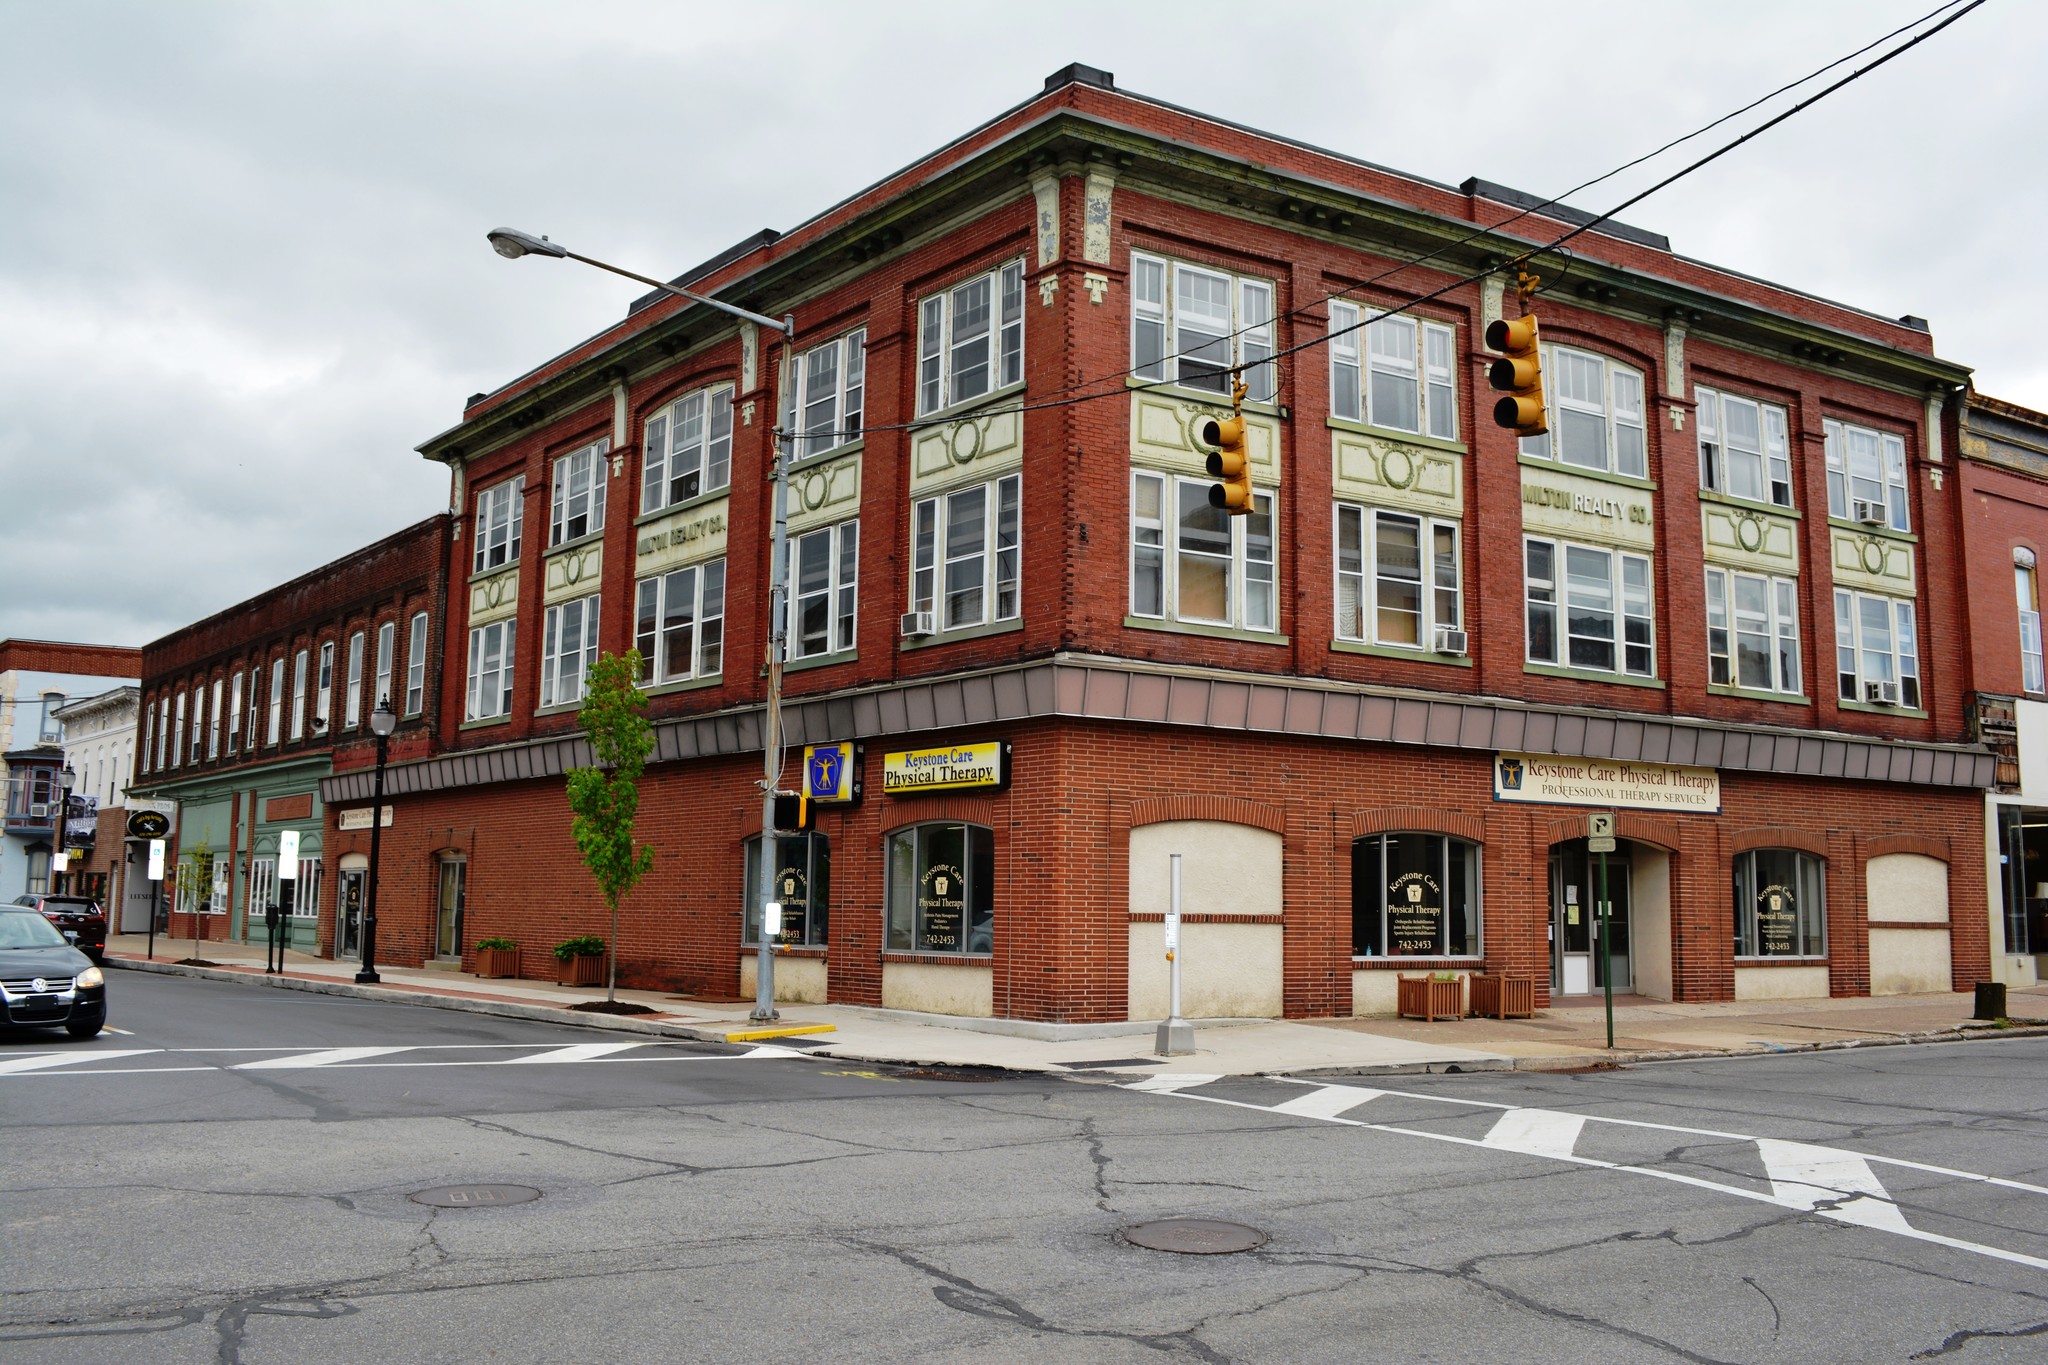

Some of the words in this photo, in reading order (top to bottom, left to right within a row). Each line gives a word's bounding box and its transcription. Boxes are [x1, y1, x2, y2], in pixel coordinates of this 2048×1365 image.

[1523, 484, 1571, 510] MILTON
[1574, 493, 1626, 520] REALTY
[1628, 504, 1652, 525] CO.
[637, 532, 668, 556] MILTON
[670, 519, 708, 546] REALTY
[905, 752, 948, 769] Keystone
[950, 748, 973, 764] Care
[885, 767, 935, 788] Physical
[940, 765, 993, 782] Therapy
[1528, 758, 1583, 782] Keystone
[1587, 763, 1616, 782] Care
[1619, 766, 1667, 788] Physical
[1670, 769, 1716, 794] Therapy
[1541, 784, 1616, 799] PROFESSIONAL
[1619, 789, 1661, 802] THERAPY
[1664, 793, 1707, 805] SERVICES
[776, 867, 796, 885] eystone
[796, 869, 808, 886] Care
[921, 864, 950, 885] Keystone
[950, 866, 964, 886] Care
[1389, 872, 1423, 893] Keystone
[1424, 874, 1440, 894] Care
[919, 897, 941, 909] Physical
[941, 897, 964, 910] Therapy
[1757, 885, 1781, 902] Keystone
[1782, 886, 1795, 903] Care
[1388, 904, 1414, 916] Physical
[1415, 904, 1441, 917] Therapy
[1757, 912, 1776, 922] Physical
[1776, 912, 1796, 922] Therapy
[926, 934, 955, 945] 742-2453
[1398, 940, 1432, 949] 742-2453
[1765, 942, 1790, 950] 742-2453
